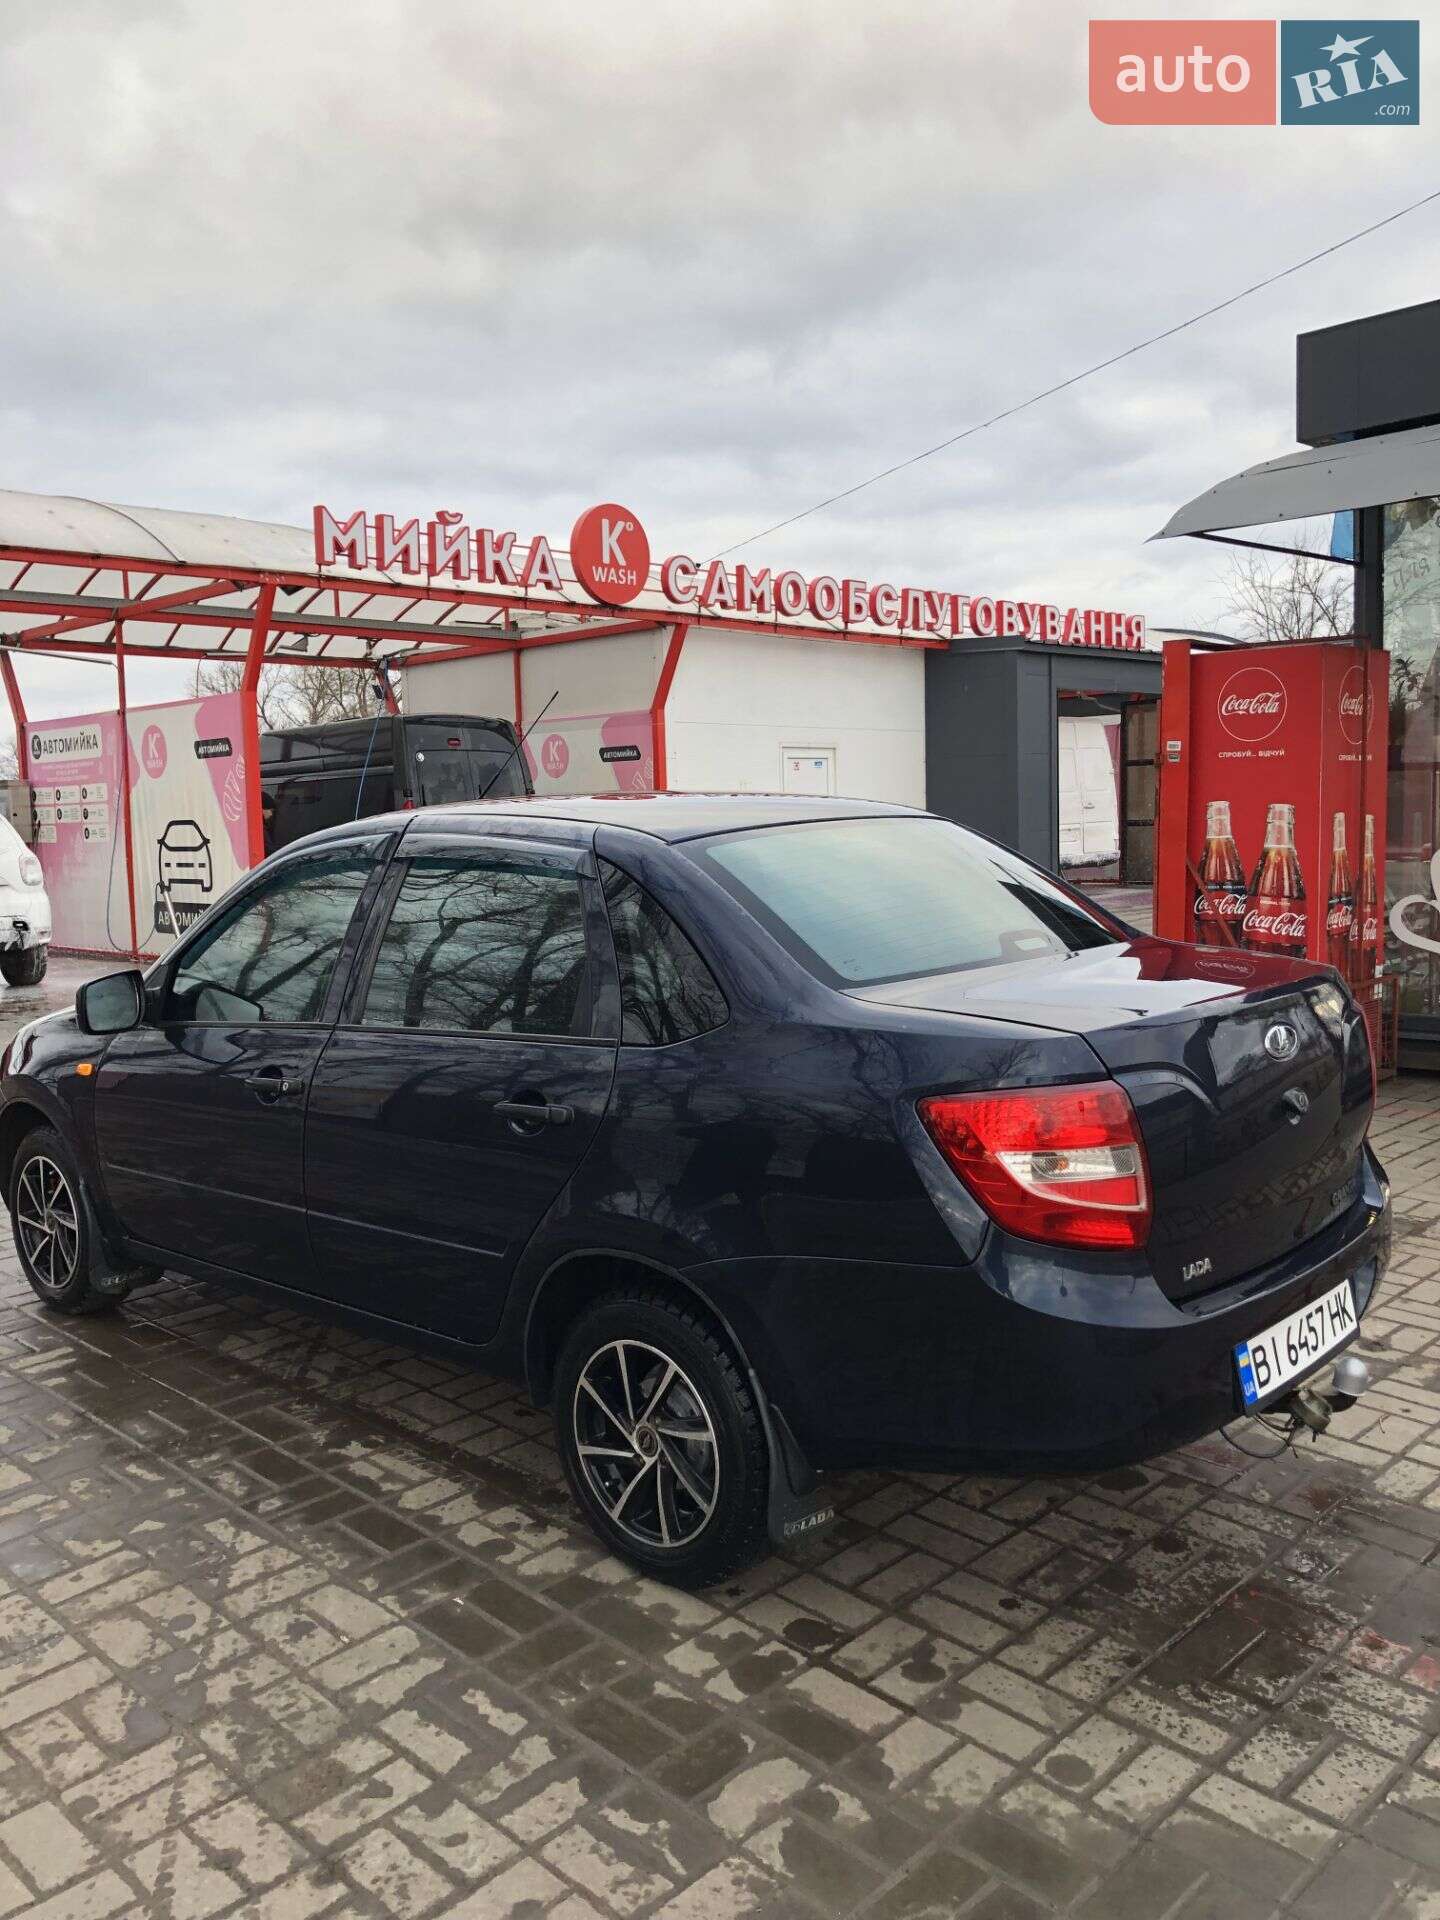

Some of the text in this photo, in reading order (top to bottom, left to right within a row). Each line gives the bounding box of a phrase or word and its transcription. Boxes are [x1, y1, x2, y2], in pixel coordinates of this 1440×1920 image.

[314, 505, 562, 590] МИЙКА
[592, 567, 637, 586] WASH
[661, 555, 1146, 649] САМООБСЛУГОВУВАННЯ
[43, 731, 99, 754] АВТОМИЙКА
[1183, 1257, 1213, 1281] LADA
[1251, 1286, 1353, 1388] BI 6457 HK
